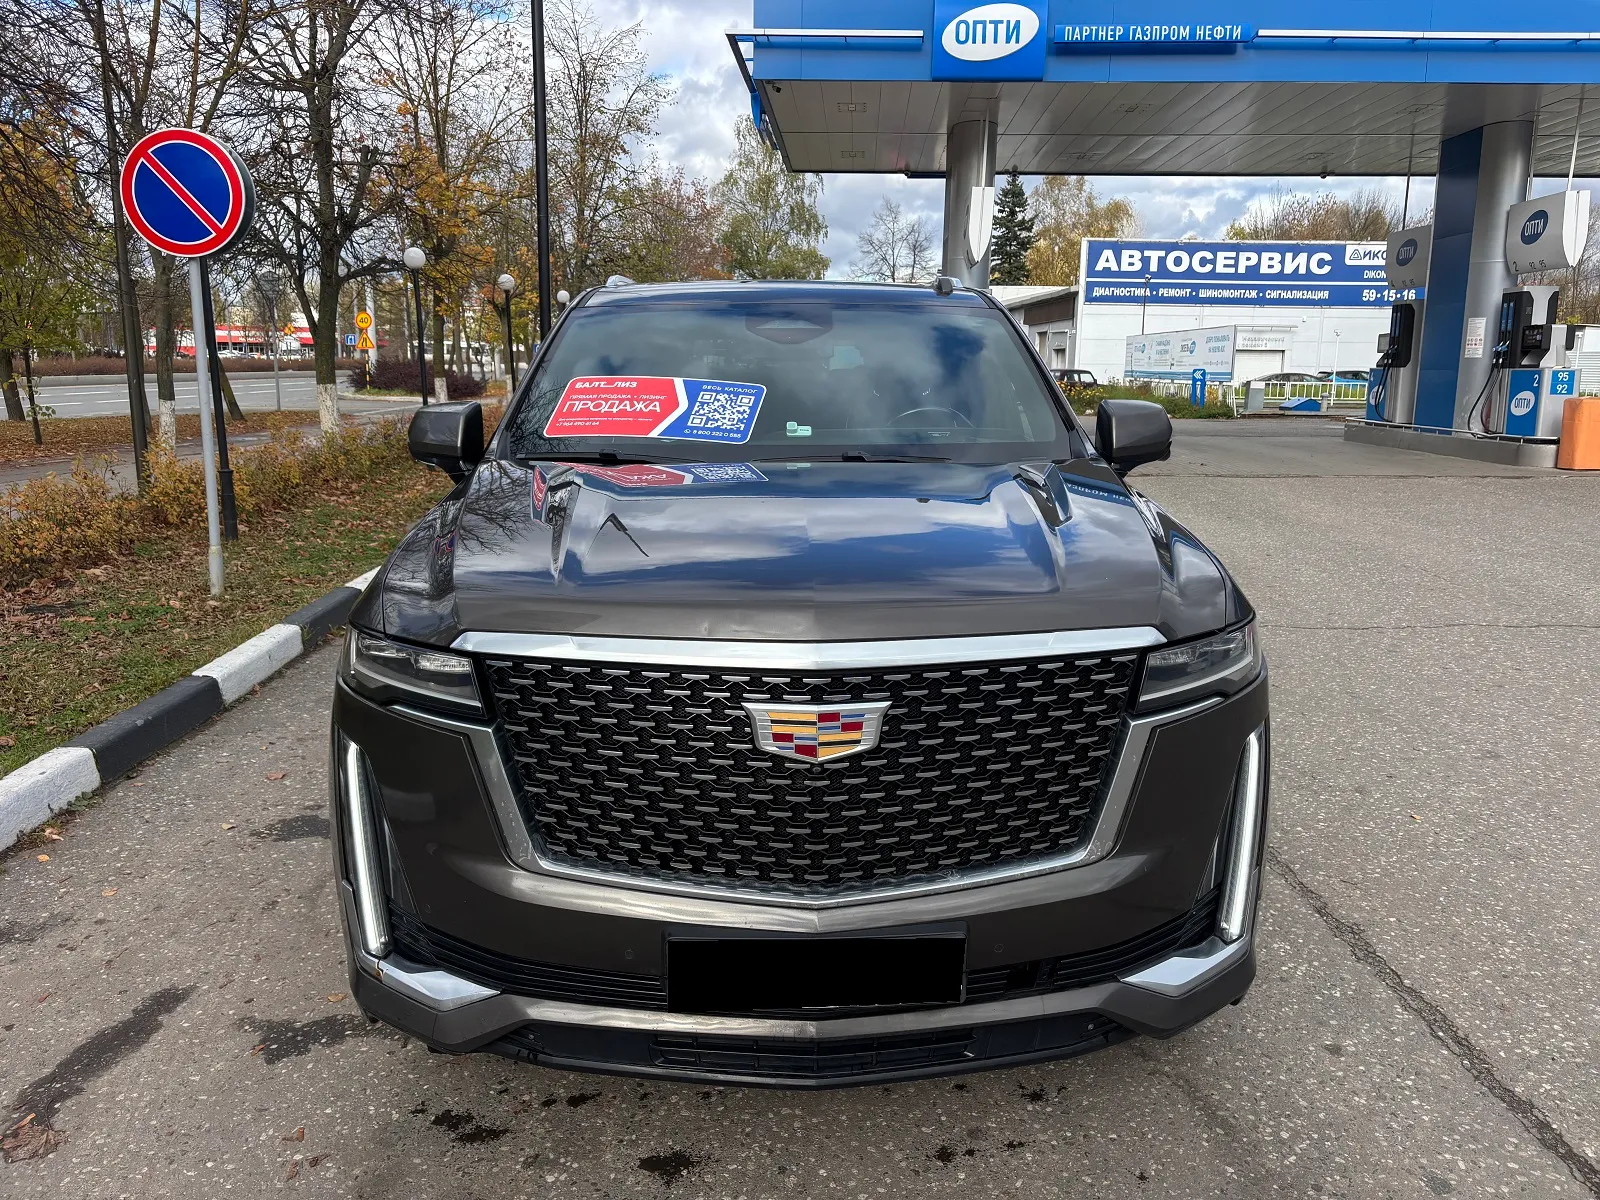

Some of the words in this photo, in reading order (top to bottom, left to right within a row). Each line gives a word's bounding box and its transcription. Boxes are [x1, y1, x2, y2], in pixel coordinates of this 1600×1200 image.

[955, 19, 1021, 45] ОПТИ
[1064, 26, 1124, 41] ПАРТНЕР
[1130, 25, 1190, 41] ГАЗПРОМ
[1196, 24, 1242, 40] НЕФТИ
[1525, 219, 1544, 236] ОПТИ
[1094, 249, 1333, 275] АВТОСЕРВИС
[1512, 261, 1519, 272] 2
[1093, 287, 1150, 297] ДИАГНОСТИКА
[1158, 288, 1192, 298] РЕМОНТ
[1199, 289, 1258, 299] ШИНОМОНТАЖ
[1265, 289, 1329, 300] СИГНАЛИЗАЦИЯ
[359, 316, 369, 324] 40
[1533, 374, 1539, 387] 2
[1557, 371, 1569, 382] 95
[724, 386, 758, 394] КАТАЛОГ
[1556, 384, 1568, 394] 92
[562, 400, 661, 413] ПРОДАЖА
[1514, 396, 1531, 409] ОПТИ
